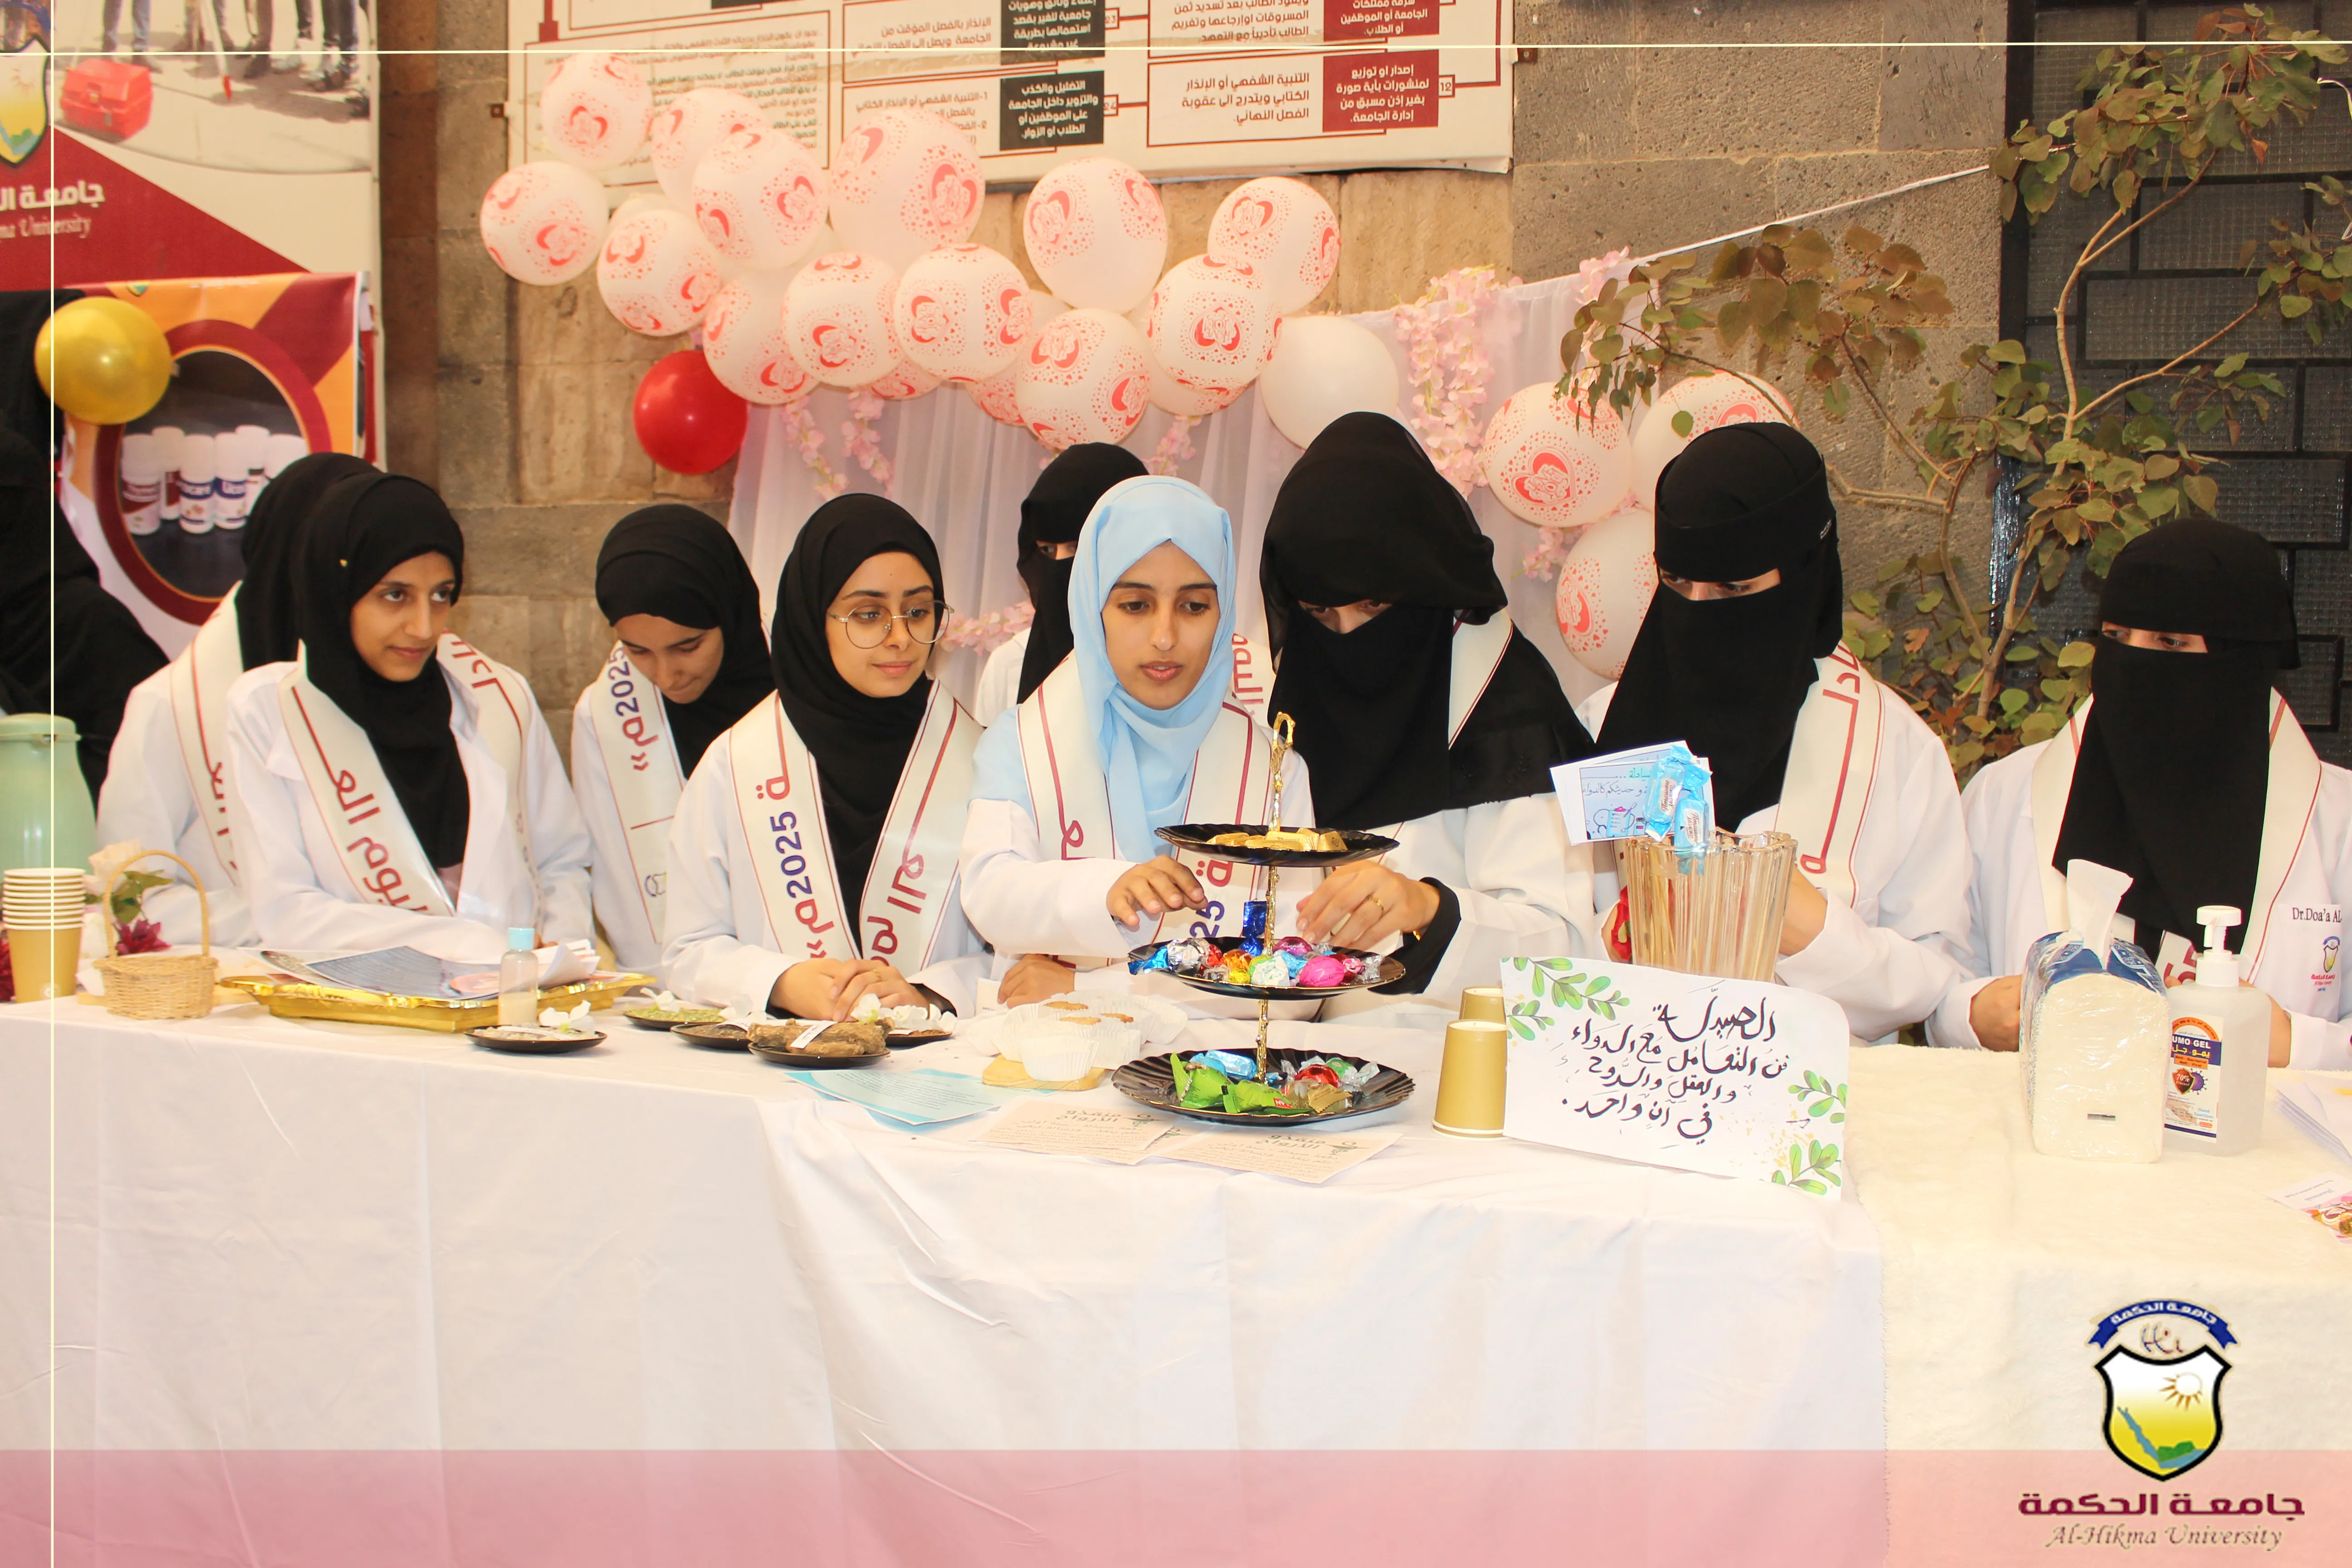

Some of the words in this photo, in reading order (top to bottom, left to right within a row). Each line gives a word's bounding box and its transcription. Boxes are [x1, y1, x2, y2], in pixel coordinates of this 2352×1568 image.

[1175, 2, 1193, 15] ثمن
[1196, 1, 1223, 13] تسديد
[1227, 0, 1242, 10] بعد
[1256, 10, 1308, 23] المسروقات
[1341, 12, 1382, 24] الموظفين
[1385, 12, 1392, 22] أو
[1395, 9, 1427, 20] الجامعة
[1172, 18, 1205, 31] وتغريم
[1395, 23, 1403, 34] أو
[1237, 32, 1250, 41] مع
[1279, 26, 1308, 37] الطالب
[1351, 67, 1377, 79] توزيع
[1390, 64, 1414, 78] إصدار
[1055, 80, 1085, 94] التضليل
[1219, 75, 1228, 90] أو
[1232, 74, 1273, 91] الشفهي
[1336, 83, 1361, 95] صورة
[1363, 79, 1381, 95] بأية
[1384, 78, 1429, 92] لمنشورات
[1440, 82, 1451, 92] 12
[1022, 83, 1054, 96] والكذب
[1009, 98, 1042, 111] الجامعة
[1044, 96, 1064, 109] داخل
[1066, 94, 1098, 107] والتزوير
[1182, 96, 1215, 109] عقوبة
[1236, 93, 1270, 107] ويتدرج
[1274, 91, 1308, 107] الكتابي
[1340, 99, 1354, 110] من
[1357, 98, 1385, 109] مسبق
[1387, 96, 1403, 108] إذن
[1406, 95, 1424, 106] بغير
[1029, 110, 1071, 125] الموظفين
[1073, 109, 1088, 122] على
[1277, 108, 1308, 122] الفصل
[1392, 109, 1414, 122] إدارة
[1057, 123, 1085, 137] الطلاب
[19, 180, 105, 209] جامعة
[1571, 1018, 1635, 1054] الدواء
[2172, 1036, 2190, 1045] UMO
[2193, 1040, 2211, 1049] GEL
[1637, 1032, 1662, 1064] مع
[1667, 1039, 1757, 1077] التعامل
[1761, 1054, 1789, 1078] فن
[2176, 1073, 2190, 1083] 70%
[1677, 1102, 1713, 1145] في
